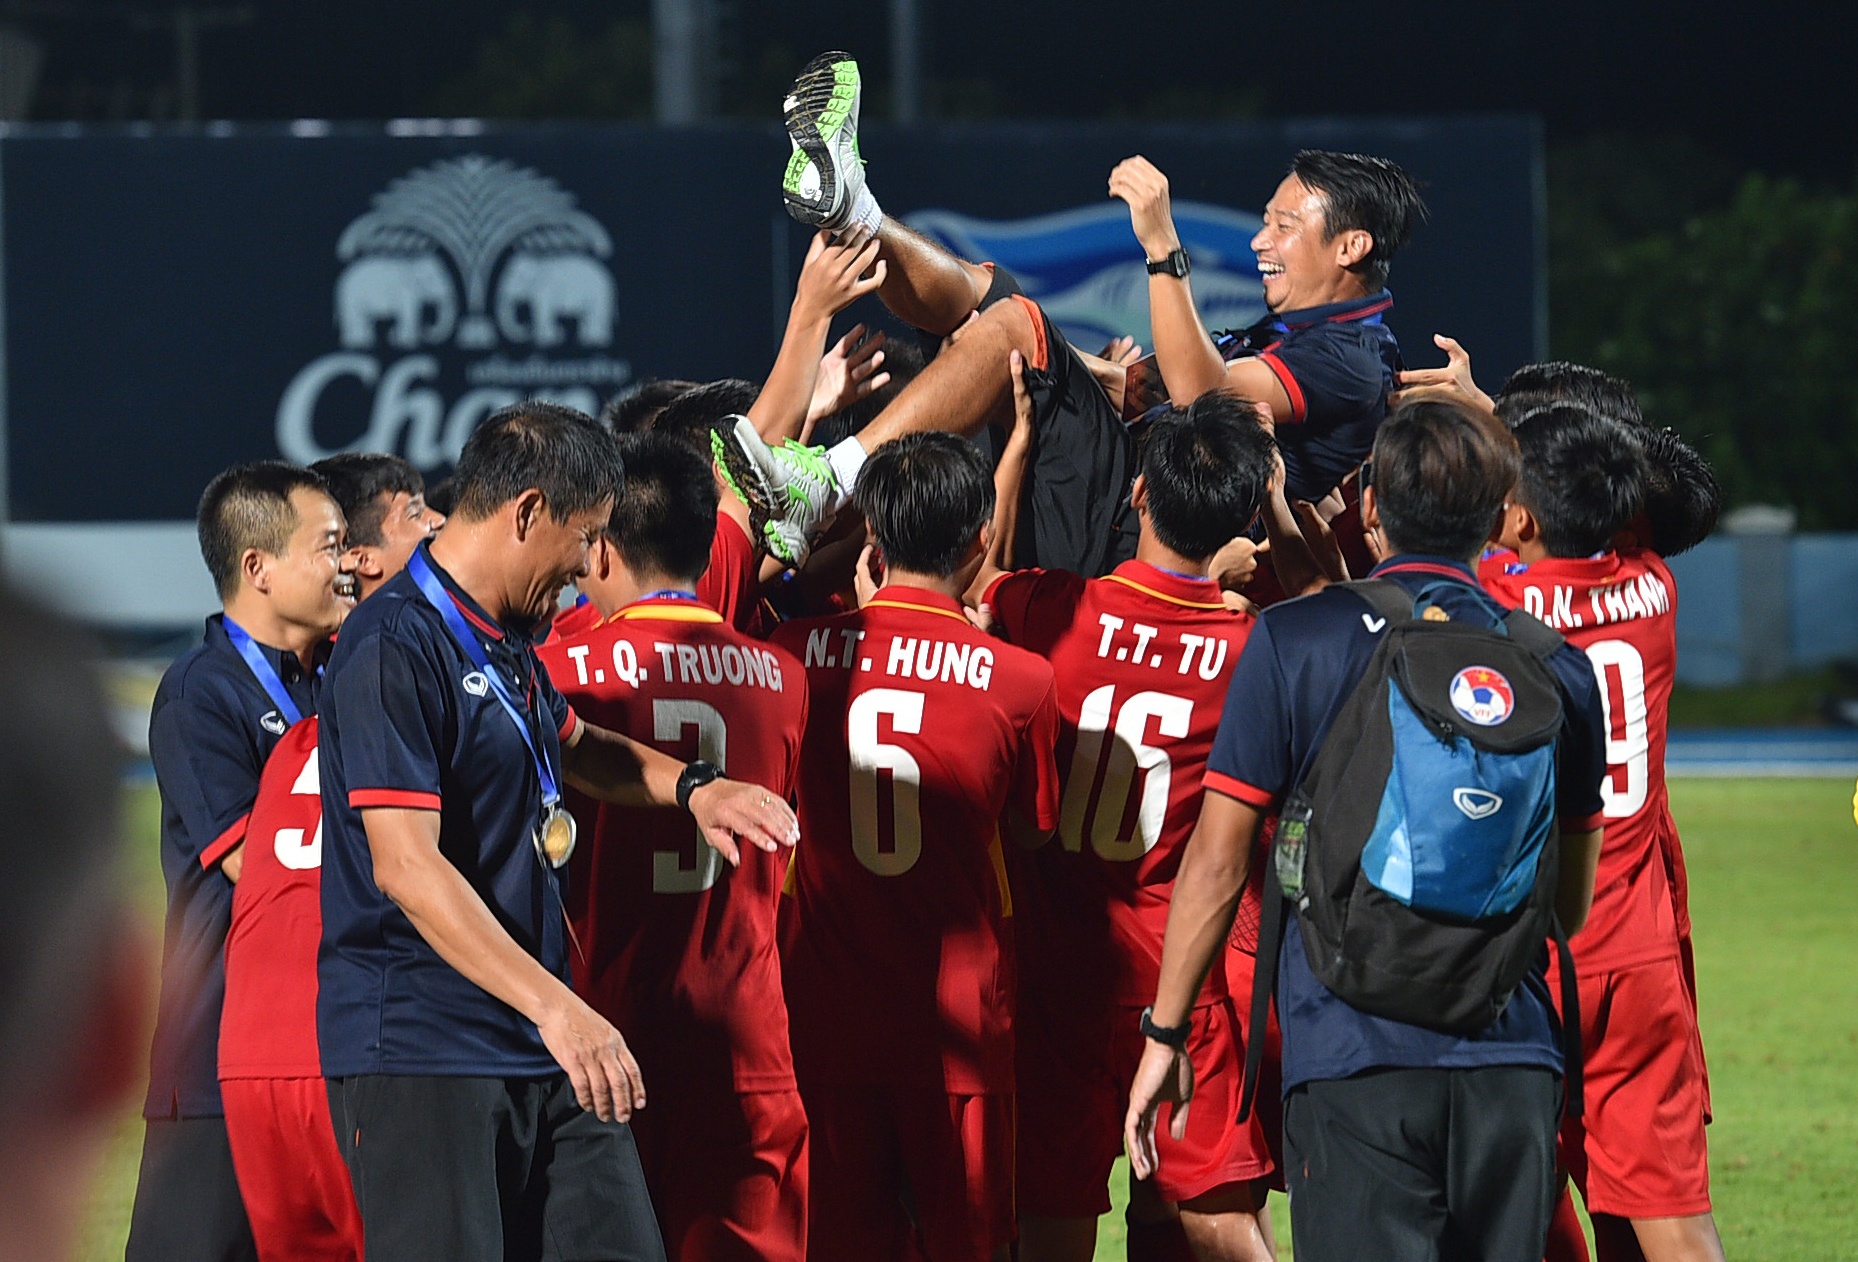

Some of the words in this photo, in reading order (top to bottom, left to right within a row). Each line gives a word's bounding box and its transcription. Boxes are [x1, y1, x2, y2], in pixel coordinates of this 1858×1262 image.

[653, 641, 783, 693] TRUONG
[805, 627, 872, 672] N.T.
[886, 635, 994, 691] HUNG
[1097, 612, 1163, 669] T.T.
[1178, 633, 1228, 681] TU
[1585, 639, 1648, 818] 9
[652, 698, 727, 894] 3
[848, 688, 926, 877] 6
[1059, 684, 1195, 862] 16
